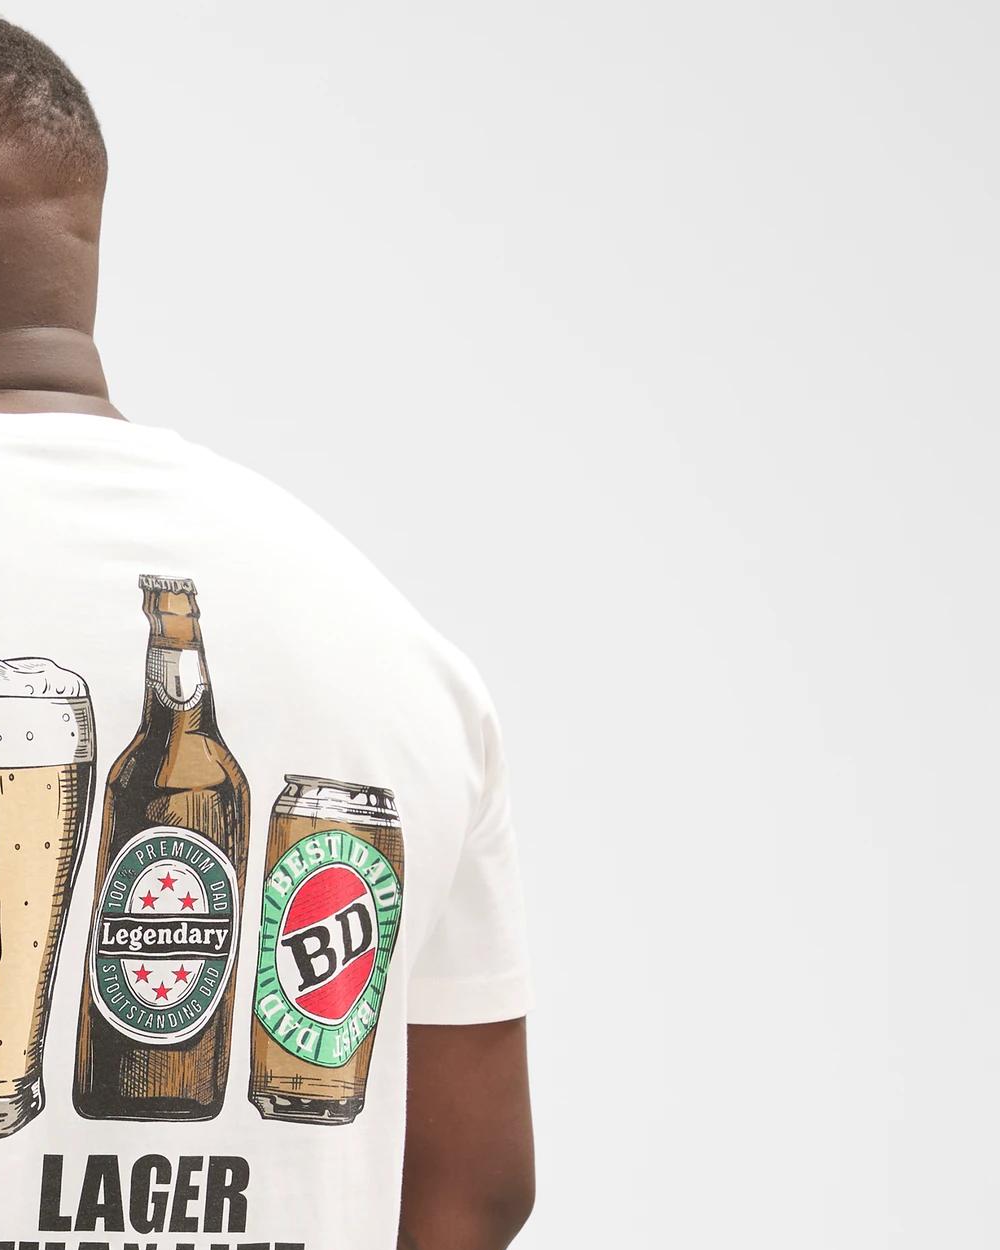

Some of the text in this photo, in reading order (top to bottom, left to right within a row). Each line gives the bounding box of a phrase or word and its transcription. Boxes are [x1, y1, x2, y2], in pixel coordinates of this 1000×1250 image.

[136, 841, 214, 874] PREMIUM
[210, 880, 228, 911] DAD
[267, 835, 398, 906] BEST DAD
[102, 922, 228, 950] Legendary
[281, 903, 373, 992] BD
[102, 964, 219, 1029] STOUTSTANDING DAD
[259, 993, 319, 1052] DAD
[38, 1153, 250, 1234] LAGER
